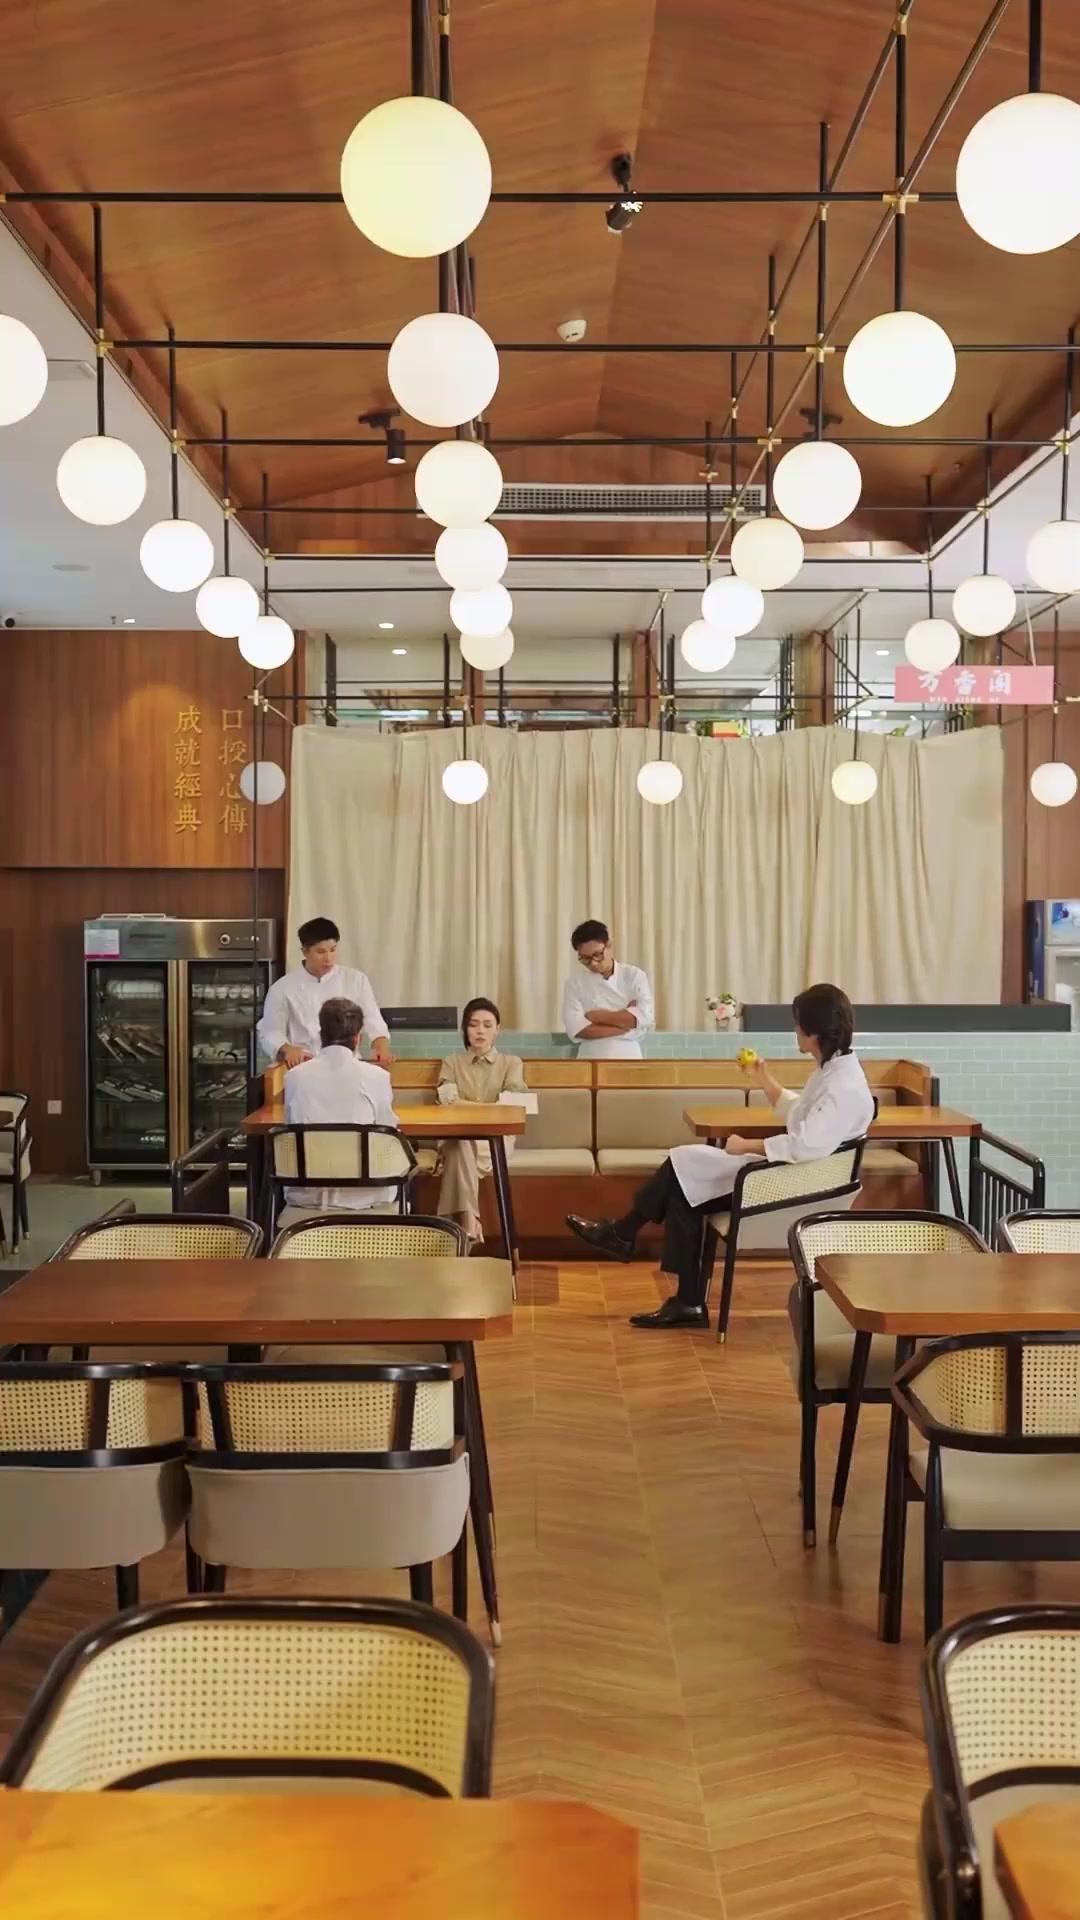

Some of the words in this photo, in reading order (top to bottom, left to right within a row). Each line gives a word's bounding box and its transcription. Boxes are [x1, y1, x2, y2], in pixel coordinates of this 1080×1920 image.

[174, 705, 202, 833] 成就經典
[218, 709, 248, 833] 口授心傳
